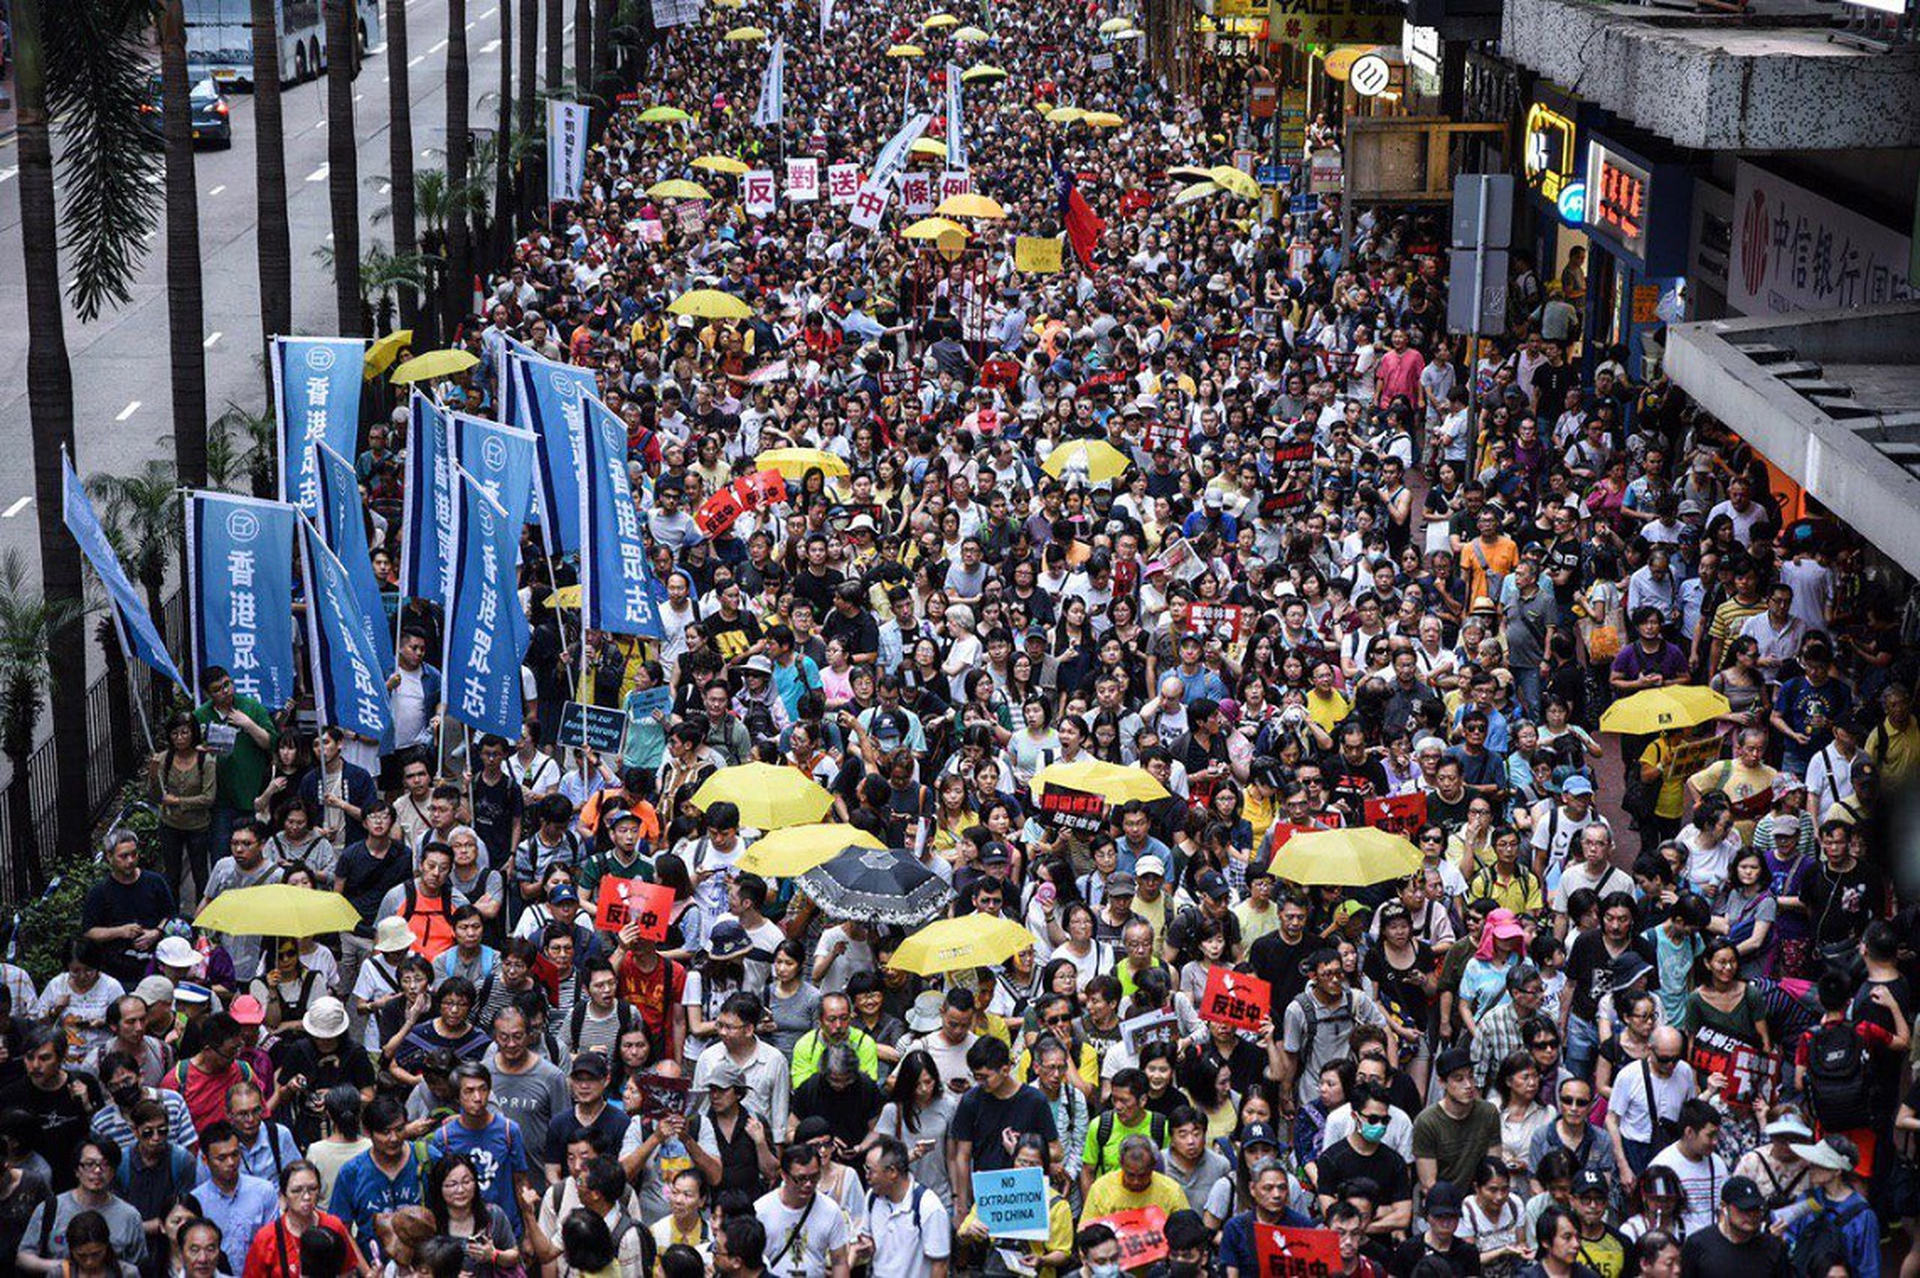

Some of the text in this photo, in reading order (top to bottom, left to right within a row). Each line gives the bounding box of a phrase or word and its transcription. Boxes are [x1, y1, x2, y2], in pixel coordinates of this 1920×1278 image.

[1280, 0, 1343, 14] YALE
[789, 164, 816, 190] 對
[831, 170, 857, 197] 送
[942, 178, 969, 200] 例
[748, 177, 773, 205] 反
[856, 190, 884, 218] 中
[902, 179, 929, 206] 條
[609, 457, 652, 624] 香港眾志
[462, 543, 499, 719] 香港眾志
[606, 903, 659, 930] 反中
[1211, 993, 1261, 1023] 反送中
[499, 1096, 539, 1110] PRIT
[1001, 1177, 1016, 1189] NO
[979, 1191, 1042, 1206] EXTRADITION
[990, 1209, 1036, 1223] TO CHINA
[1118, 1230, 1164, 1258] 送中
[1269, 1253, 1330, 1278] 反送中
